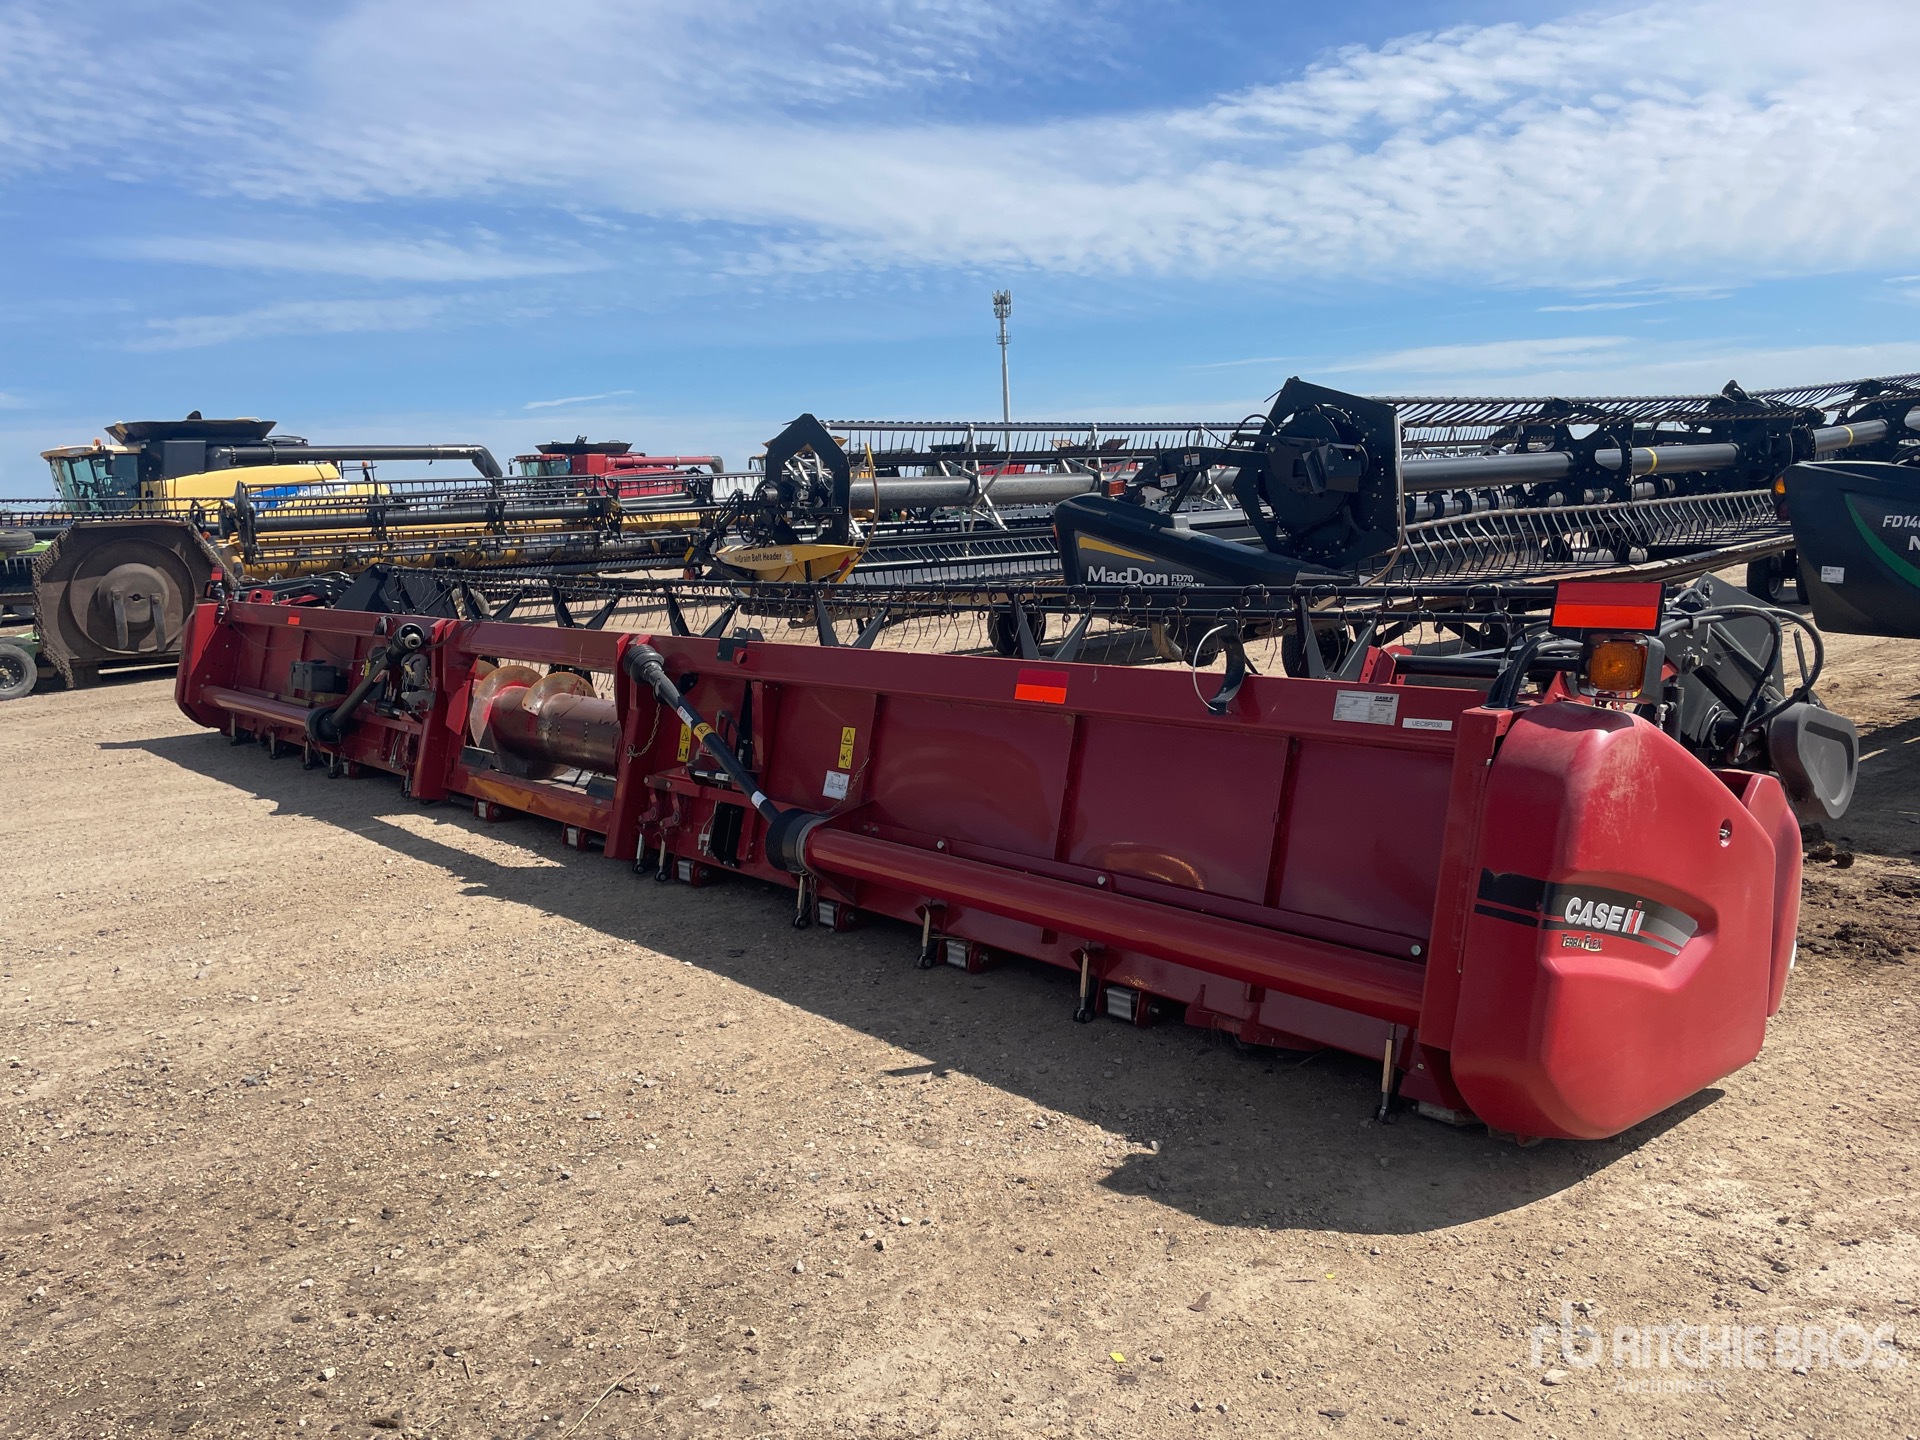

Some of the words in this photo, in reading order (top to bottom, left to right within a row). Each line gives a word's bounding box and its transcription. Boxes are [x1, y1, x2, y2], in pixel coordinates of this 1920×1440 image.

[752, 553, 762, 562] Belt
[763, 552, 782, 561] Header
[1087, 565, 1168, 586] MacDon
[1171, 574, 1194, 582] FD70
[1565, 897, 1625, 932] CASE
